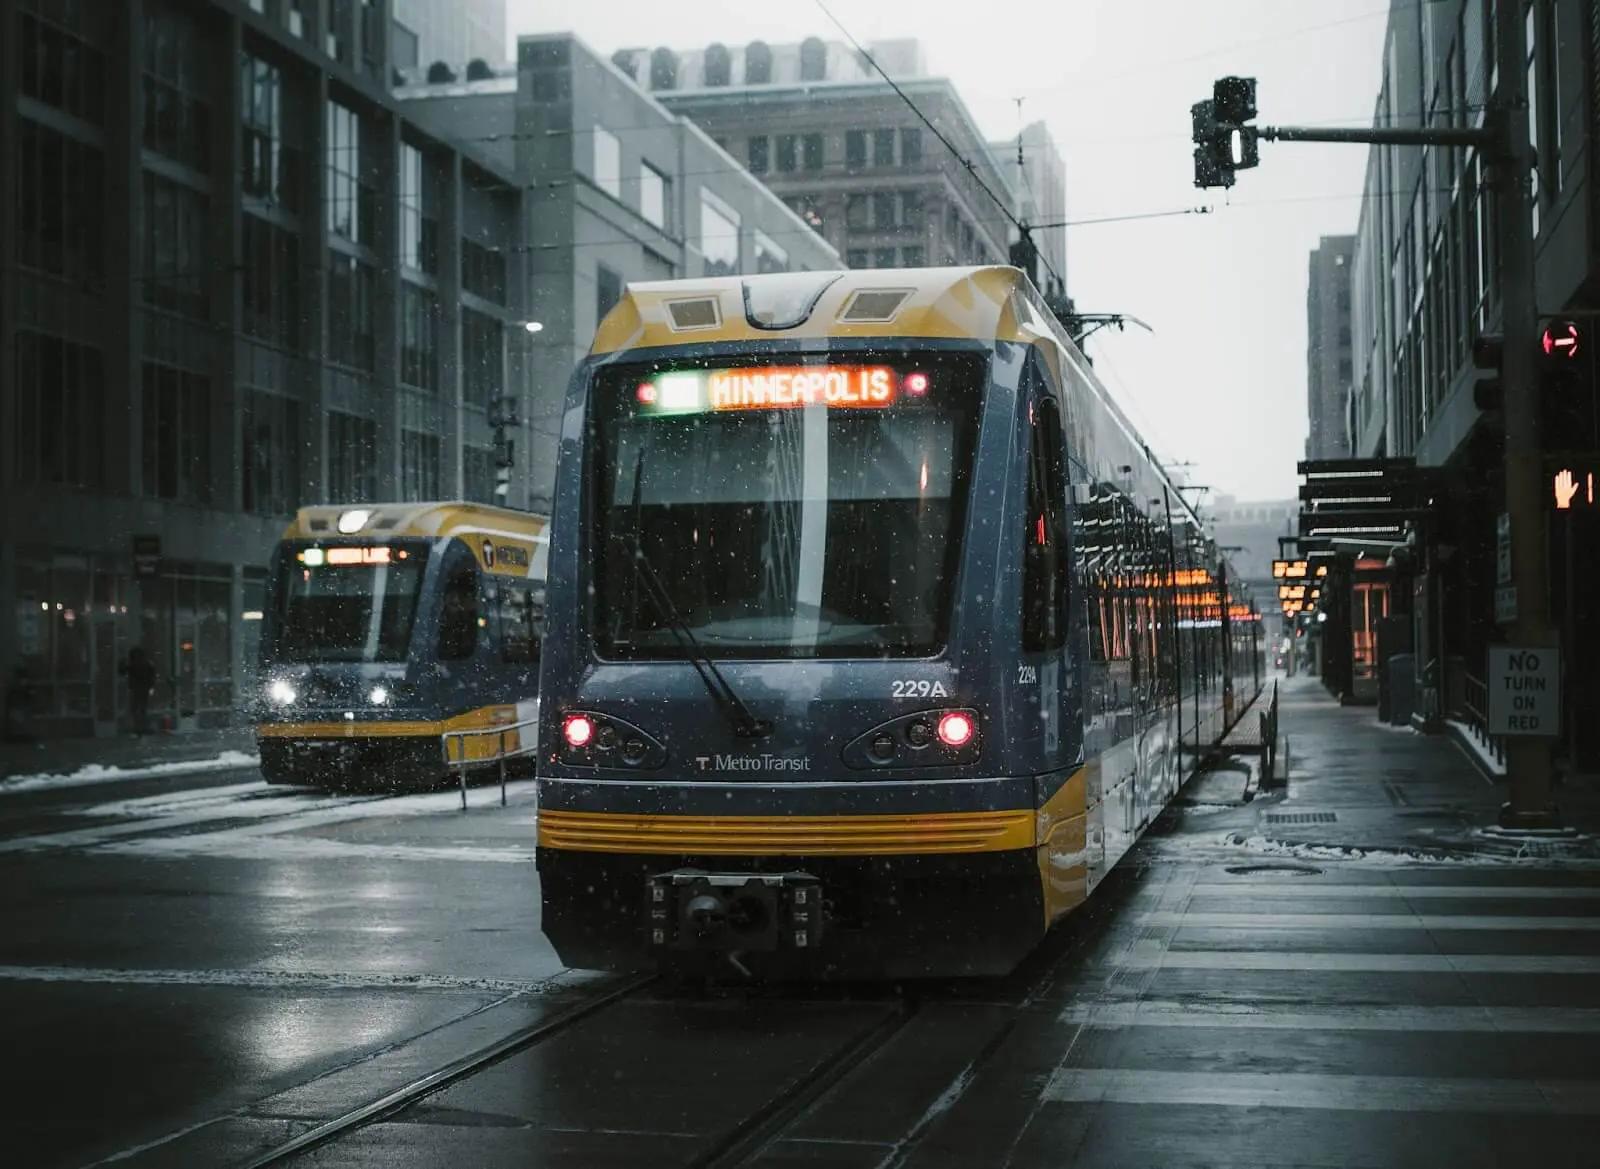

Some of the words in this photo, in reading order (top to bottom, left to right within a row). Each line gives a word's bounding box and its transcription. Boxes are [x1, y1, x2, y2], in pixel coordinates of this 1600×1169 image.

[714, 370, 889, 404] MINNEAPOLIS
[1508, 654, 1540, 671] NO
[1018, 665, 1036, 685] 229A
[1503, 676, 1546, 691] TURN
[892, 680, 948, 698] 229A
[1513, 695, 1536, 710] ON
[1508, 715, 1539, 729] RED
